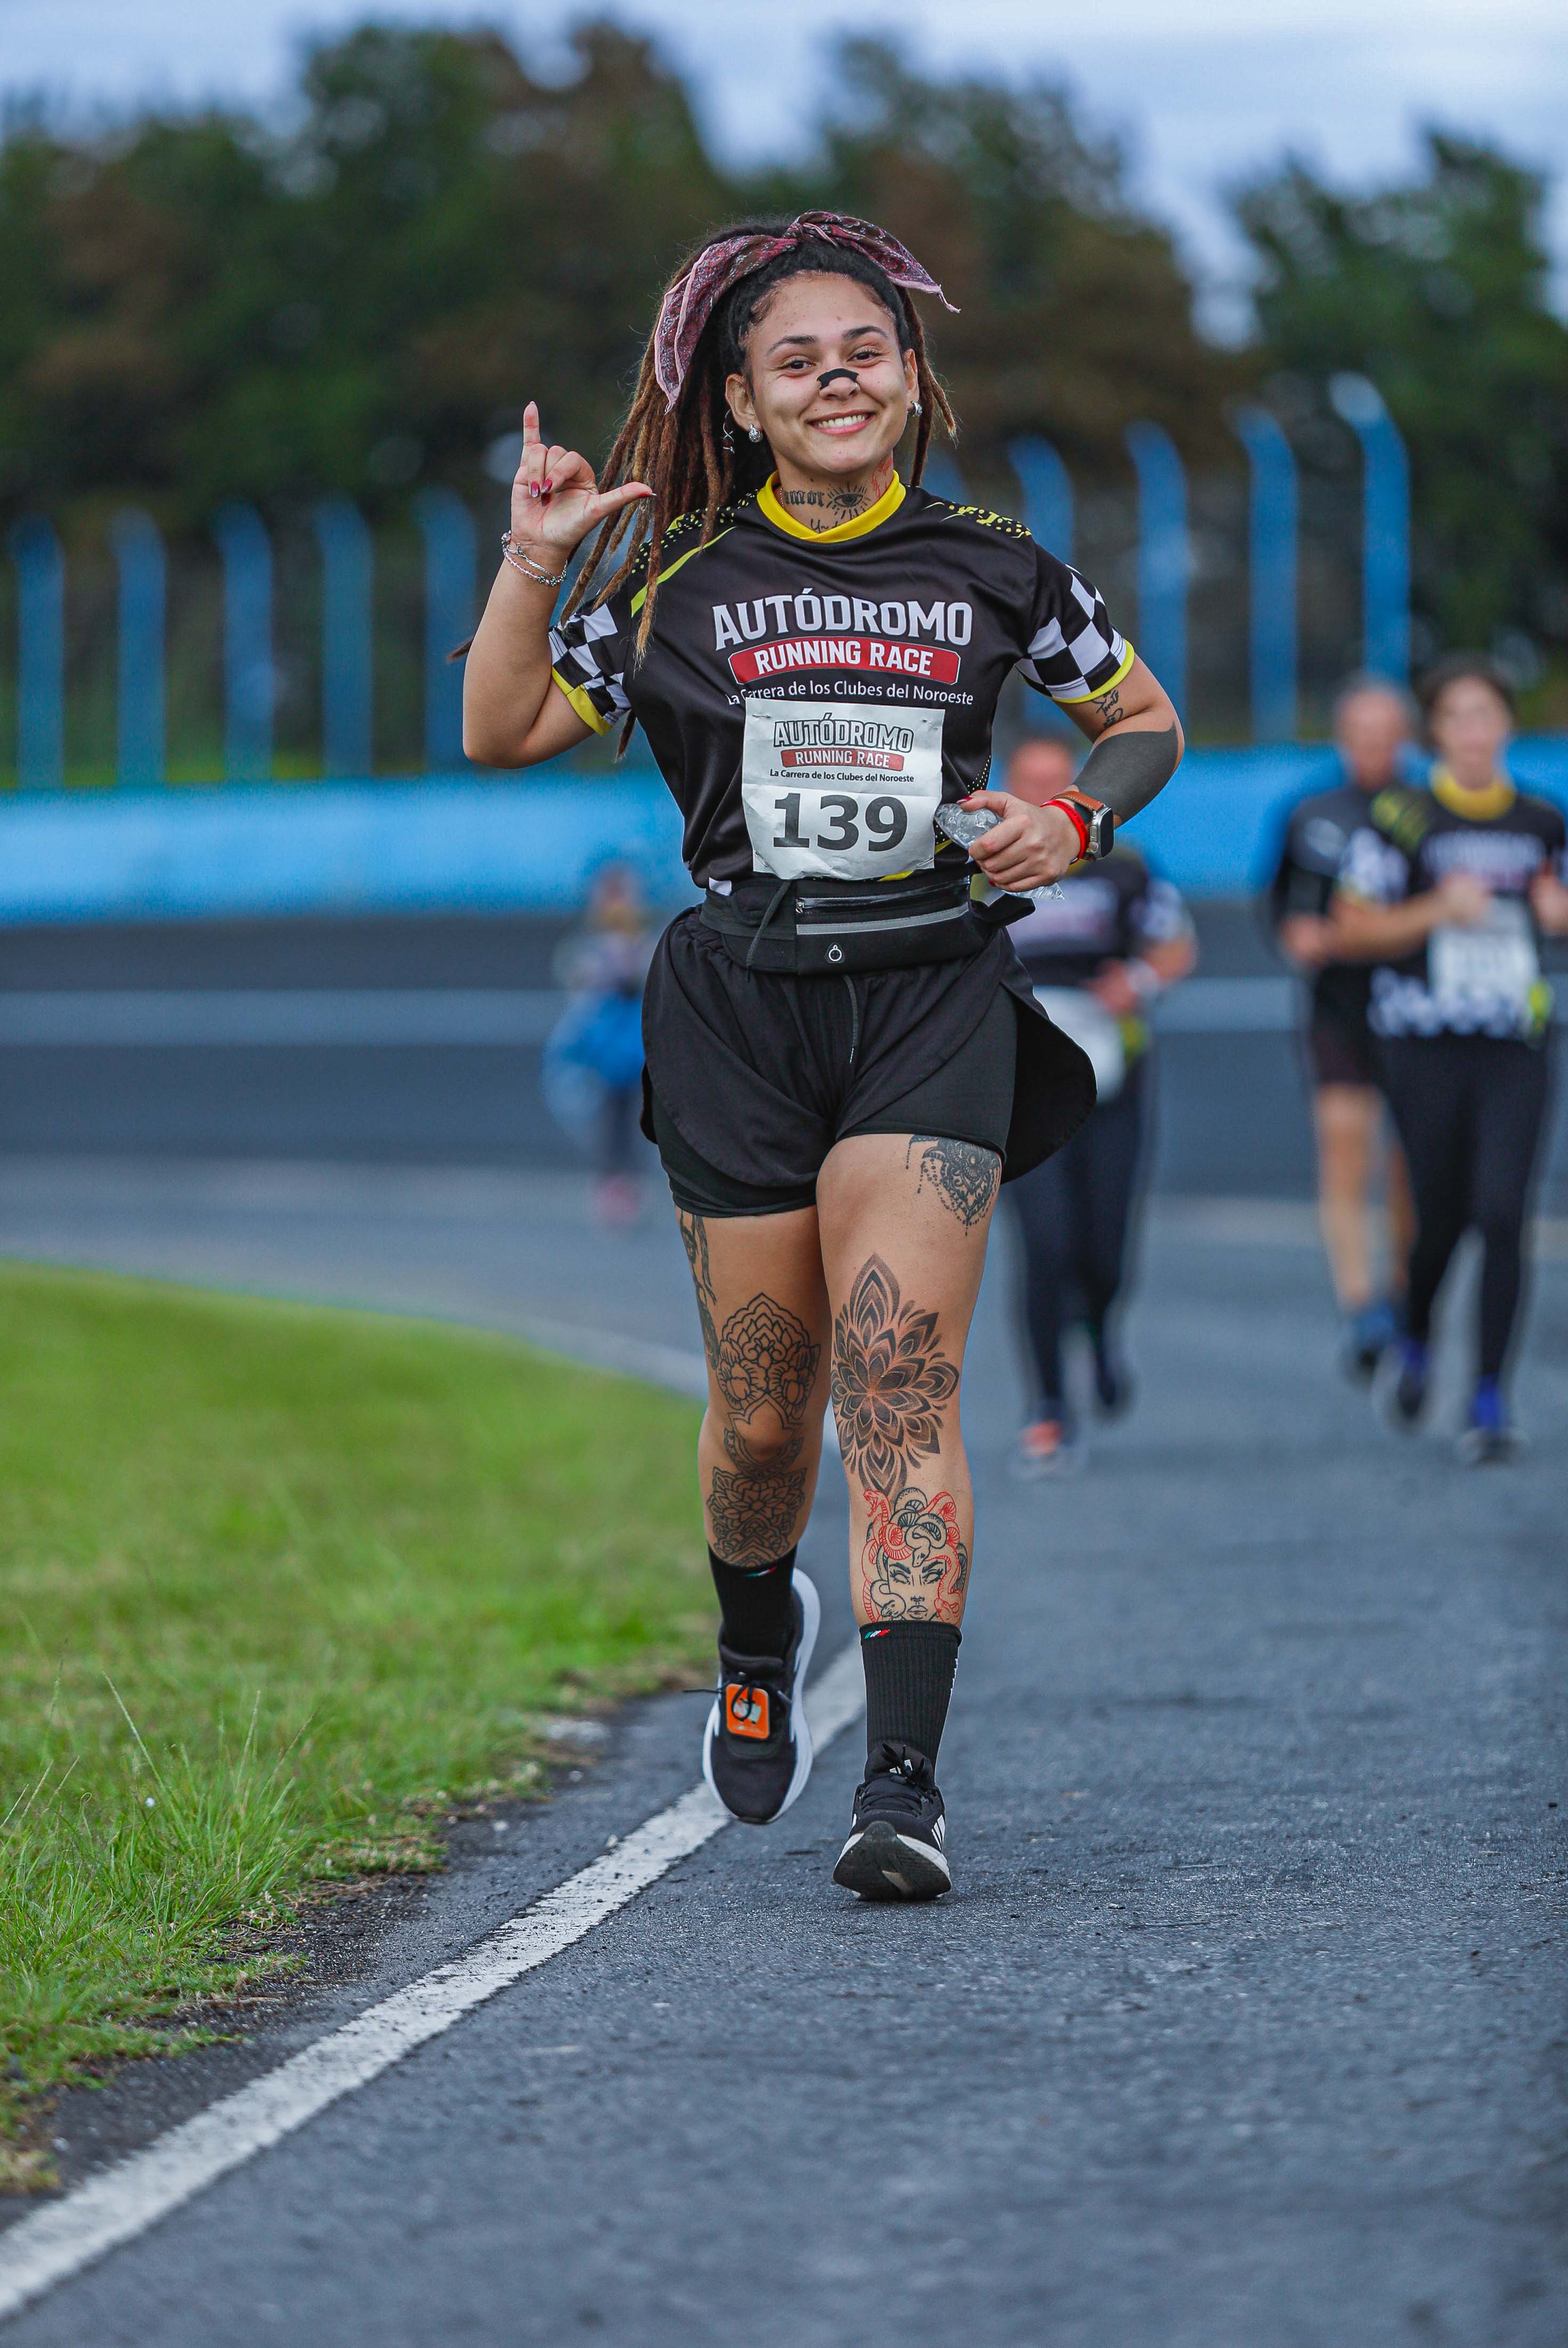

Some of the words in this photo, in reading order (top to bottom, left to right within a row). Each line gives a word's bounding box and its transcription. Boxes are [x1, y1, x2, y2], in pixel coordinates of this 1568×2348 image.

[712, 588, 972, 651] AUTÓDROMO
[753, 640, 861, 676] RUNNING
[869, 641, 933, 676] RACE
[725, 694, 741, 705] La
[789, 681, 806, 695] de
[810, 680, 830, 695] los
[834, 680, 882, 696] Clubes
[887, 683, 909, 698] del
[913, 685, 973, 705] Noroeste
[774, 712, 914, 753] AUTÓDROMO
[770, 769, 779, 777] La
[781, 770, 810, 778] Carrera
[811, 770, 822, 779] de
[824, 771, 835, 780] los
[836, 771, 864, 781] Clubes
[865, 772, 878, 782] del
[879, 774, 915, 783] Noroeste
[795, 749, 852, 765] RUNNING
[857, 751, 891, 768] RACE
[773, 792, 908, 852] 139
